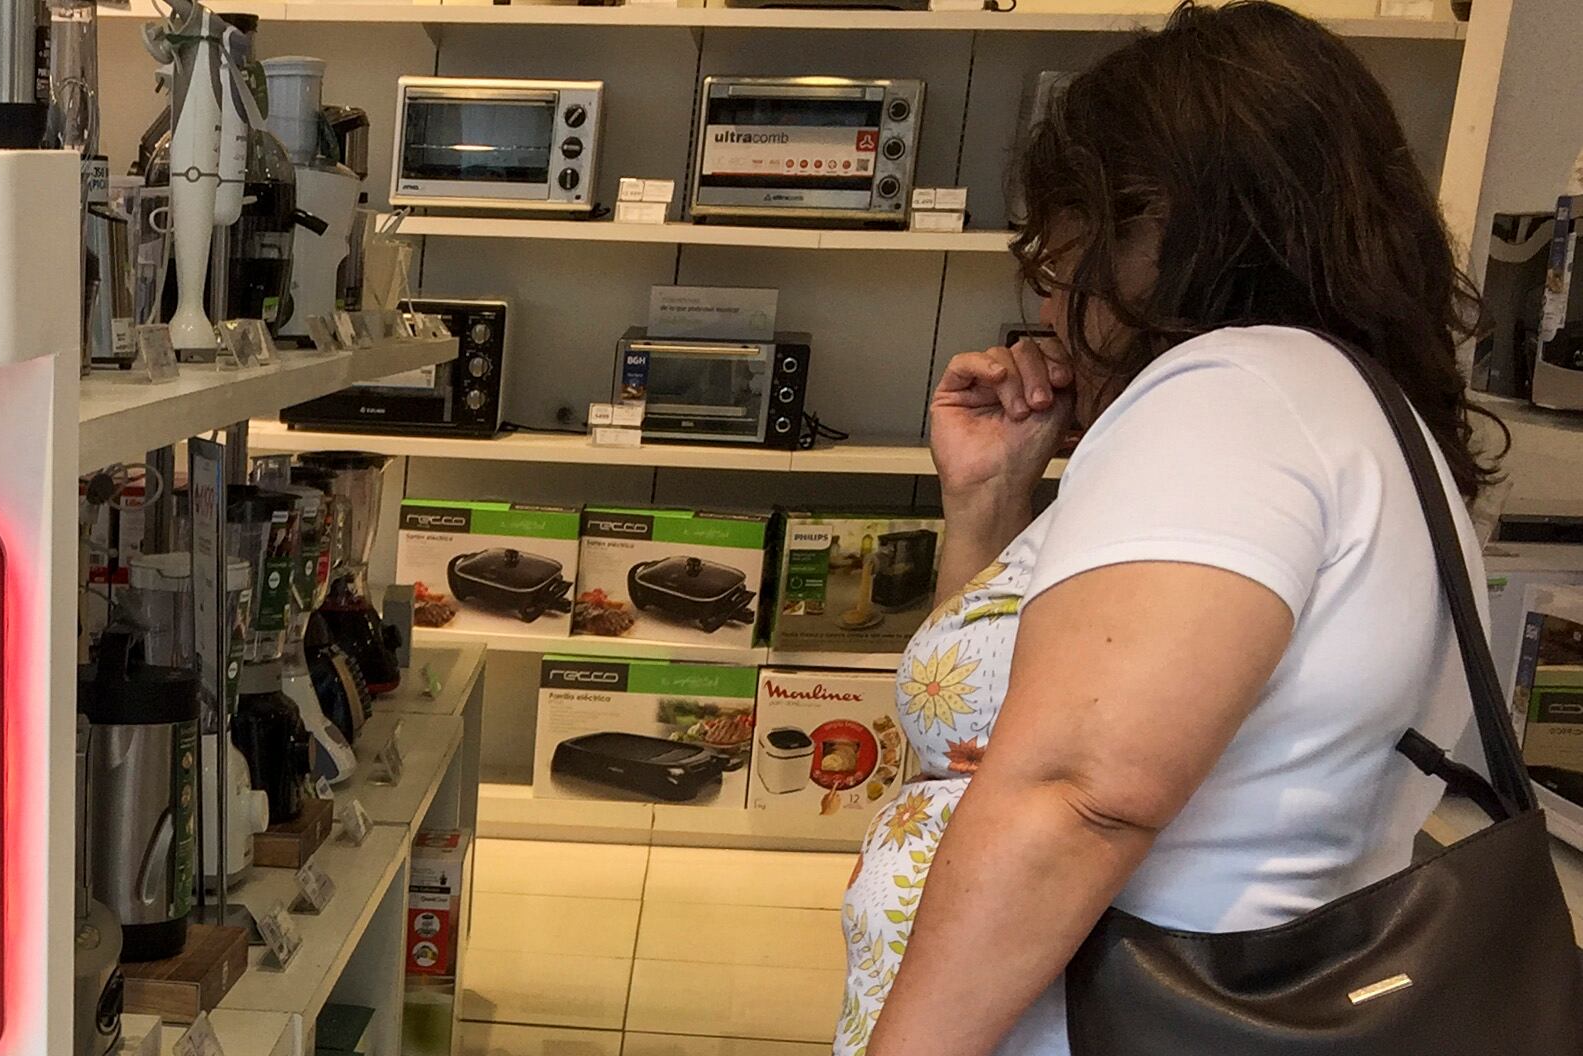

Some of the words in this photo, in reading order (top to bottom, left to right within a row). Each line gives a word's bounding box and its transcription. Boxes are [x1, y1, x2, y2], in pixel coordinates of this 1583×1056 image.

[714, 130, 790, 145] ultracomb
[626, 355, 646, 366] BGH
[794, 533, 829, 542] PHILIPS
[762, 679, 865, 703] Moulinex
